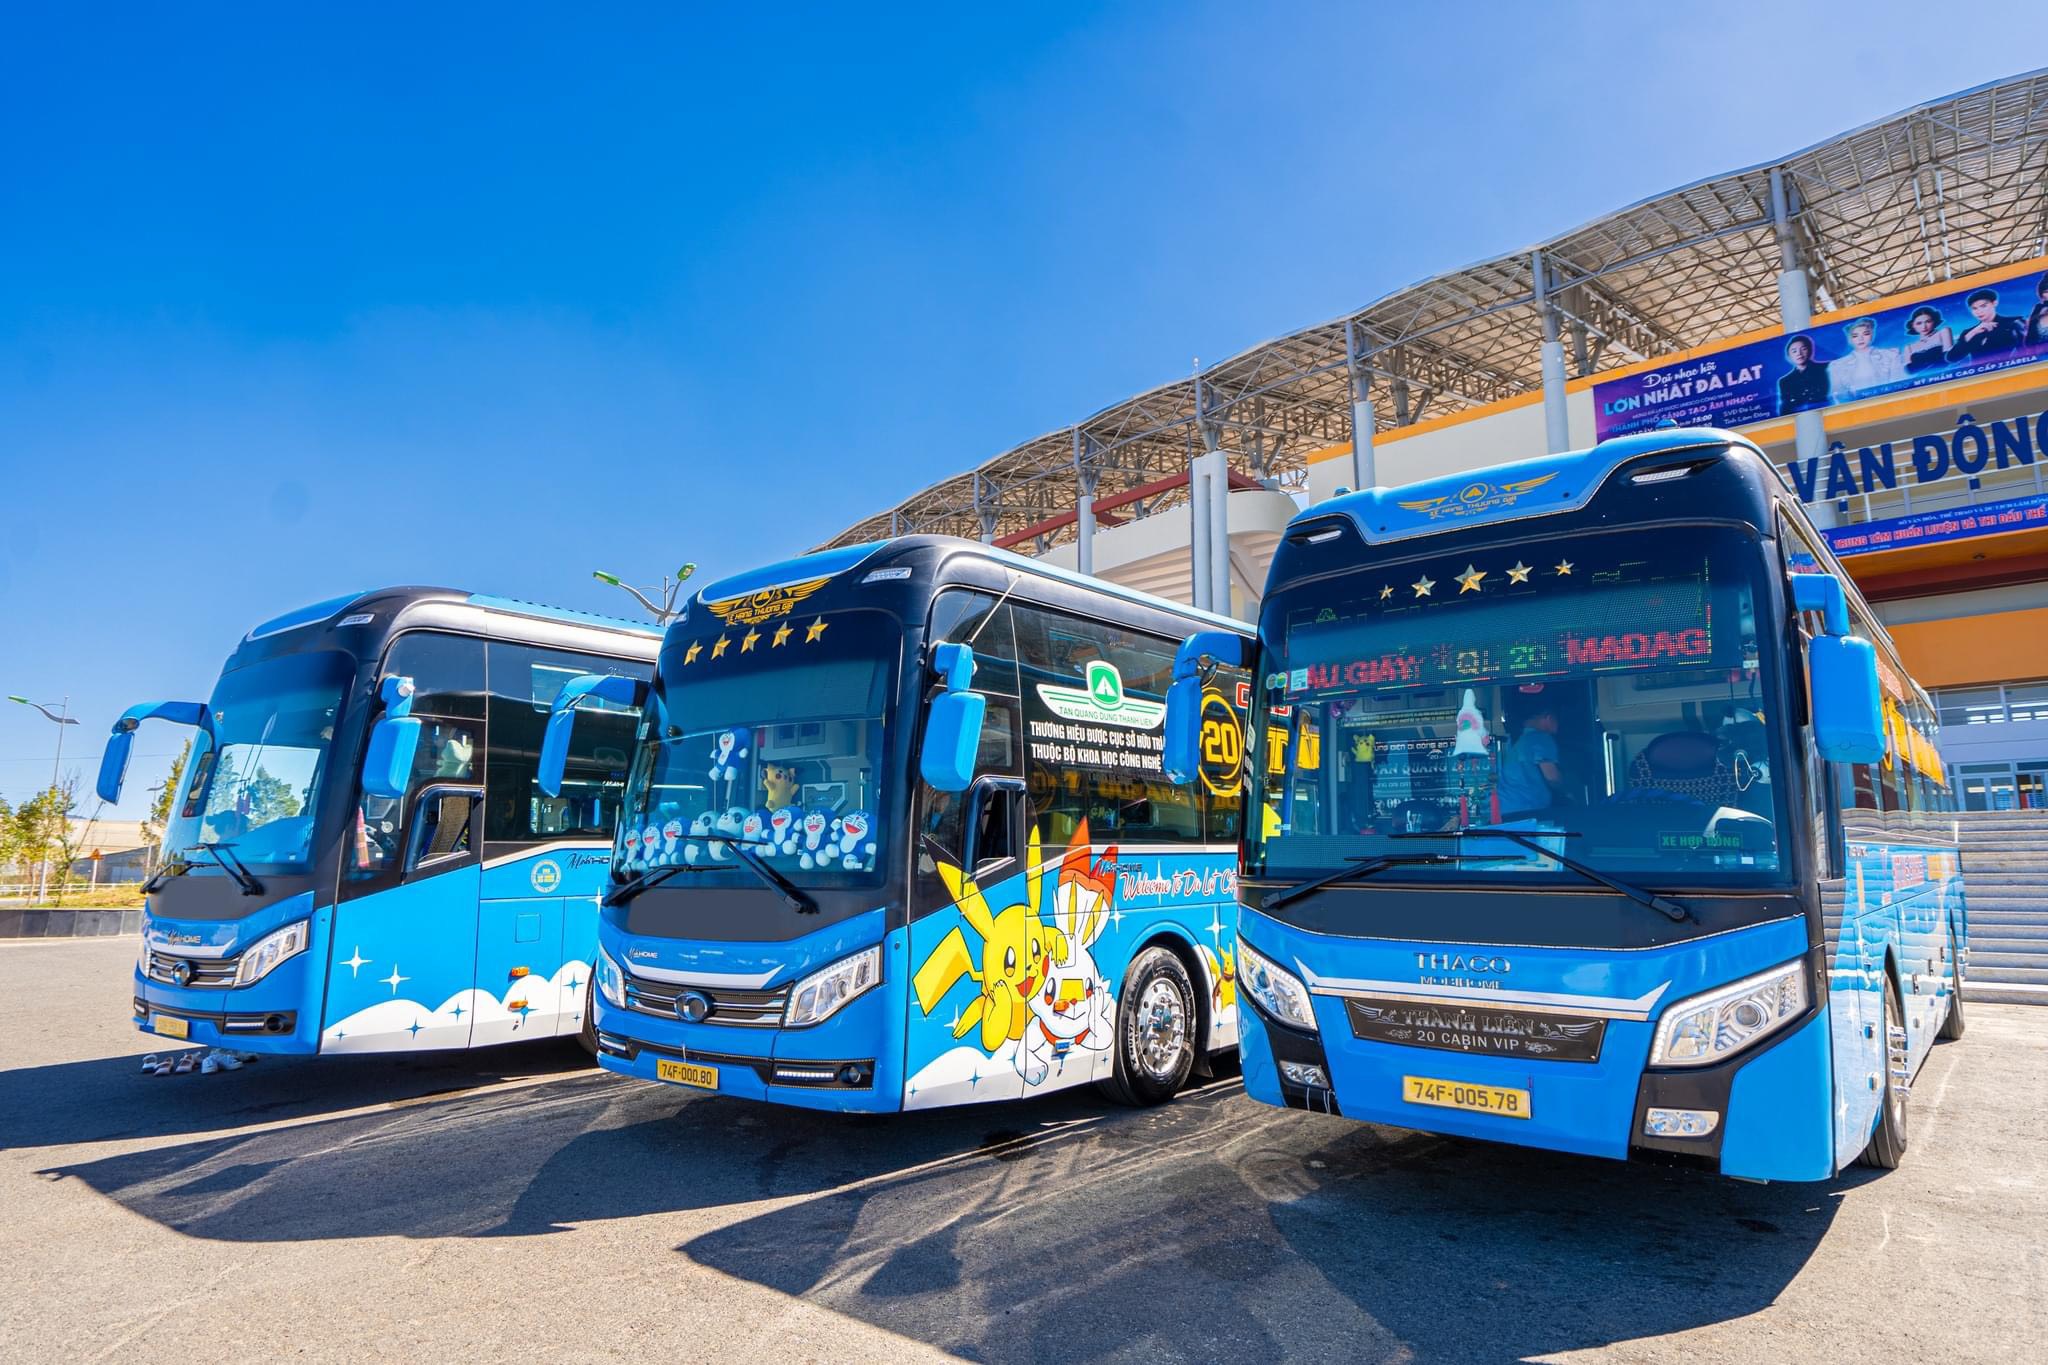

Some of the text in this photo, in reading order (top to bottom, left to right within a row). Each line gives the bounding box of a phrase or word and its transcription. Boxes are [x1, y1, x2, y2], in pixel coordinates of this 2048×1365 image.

[1787, 440, 1897, 513] VẬN
[1833, 535, 1869, 550] TRUNG
[1030, 720, 1065, 740] THƯƠNG
[1066, 724, 1086, 744] HIỆU
[1086, 727, 1108, 746] ĐƯỢC
[1109, 731, 1125, 749] CỤC
[1125, 729, 1136, 748] SỞ
[1137, 732, 1151, 750] HỮU
[1202, 720, 1239, 765] 20
[1031, 742, 1162, 772] THUỘC BỘ KHOA HỌC CÔNG NGHỆ
[1662, 835, 1677, 847] XE
[1119, 872, 1171, 901] Welcome
[1413, 951, 1512, 974] THACO
[1420, 974, 1505, 990] MOBIHOME
[1402, 1007, 1536, 1036] THÀNH LIÊN
[1417, 1030, 1520, 1050] 20 CABIN VIP
[661, 1063, 712, 1085] 74F-000.80
[1413, 1081, 1518, 1111] 74F-005.78
